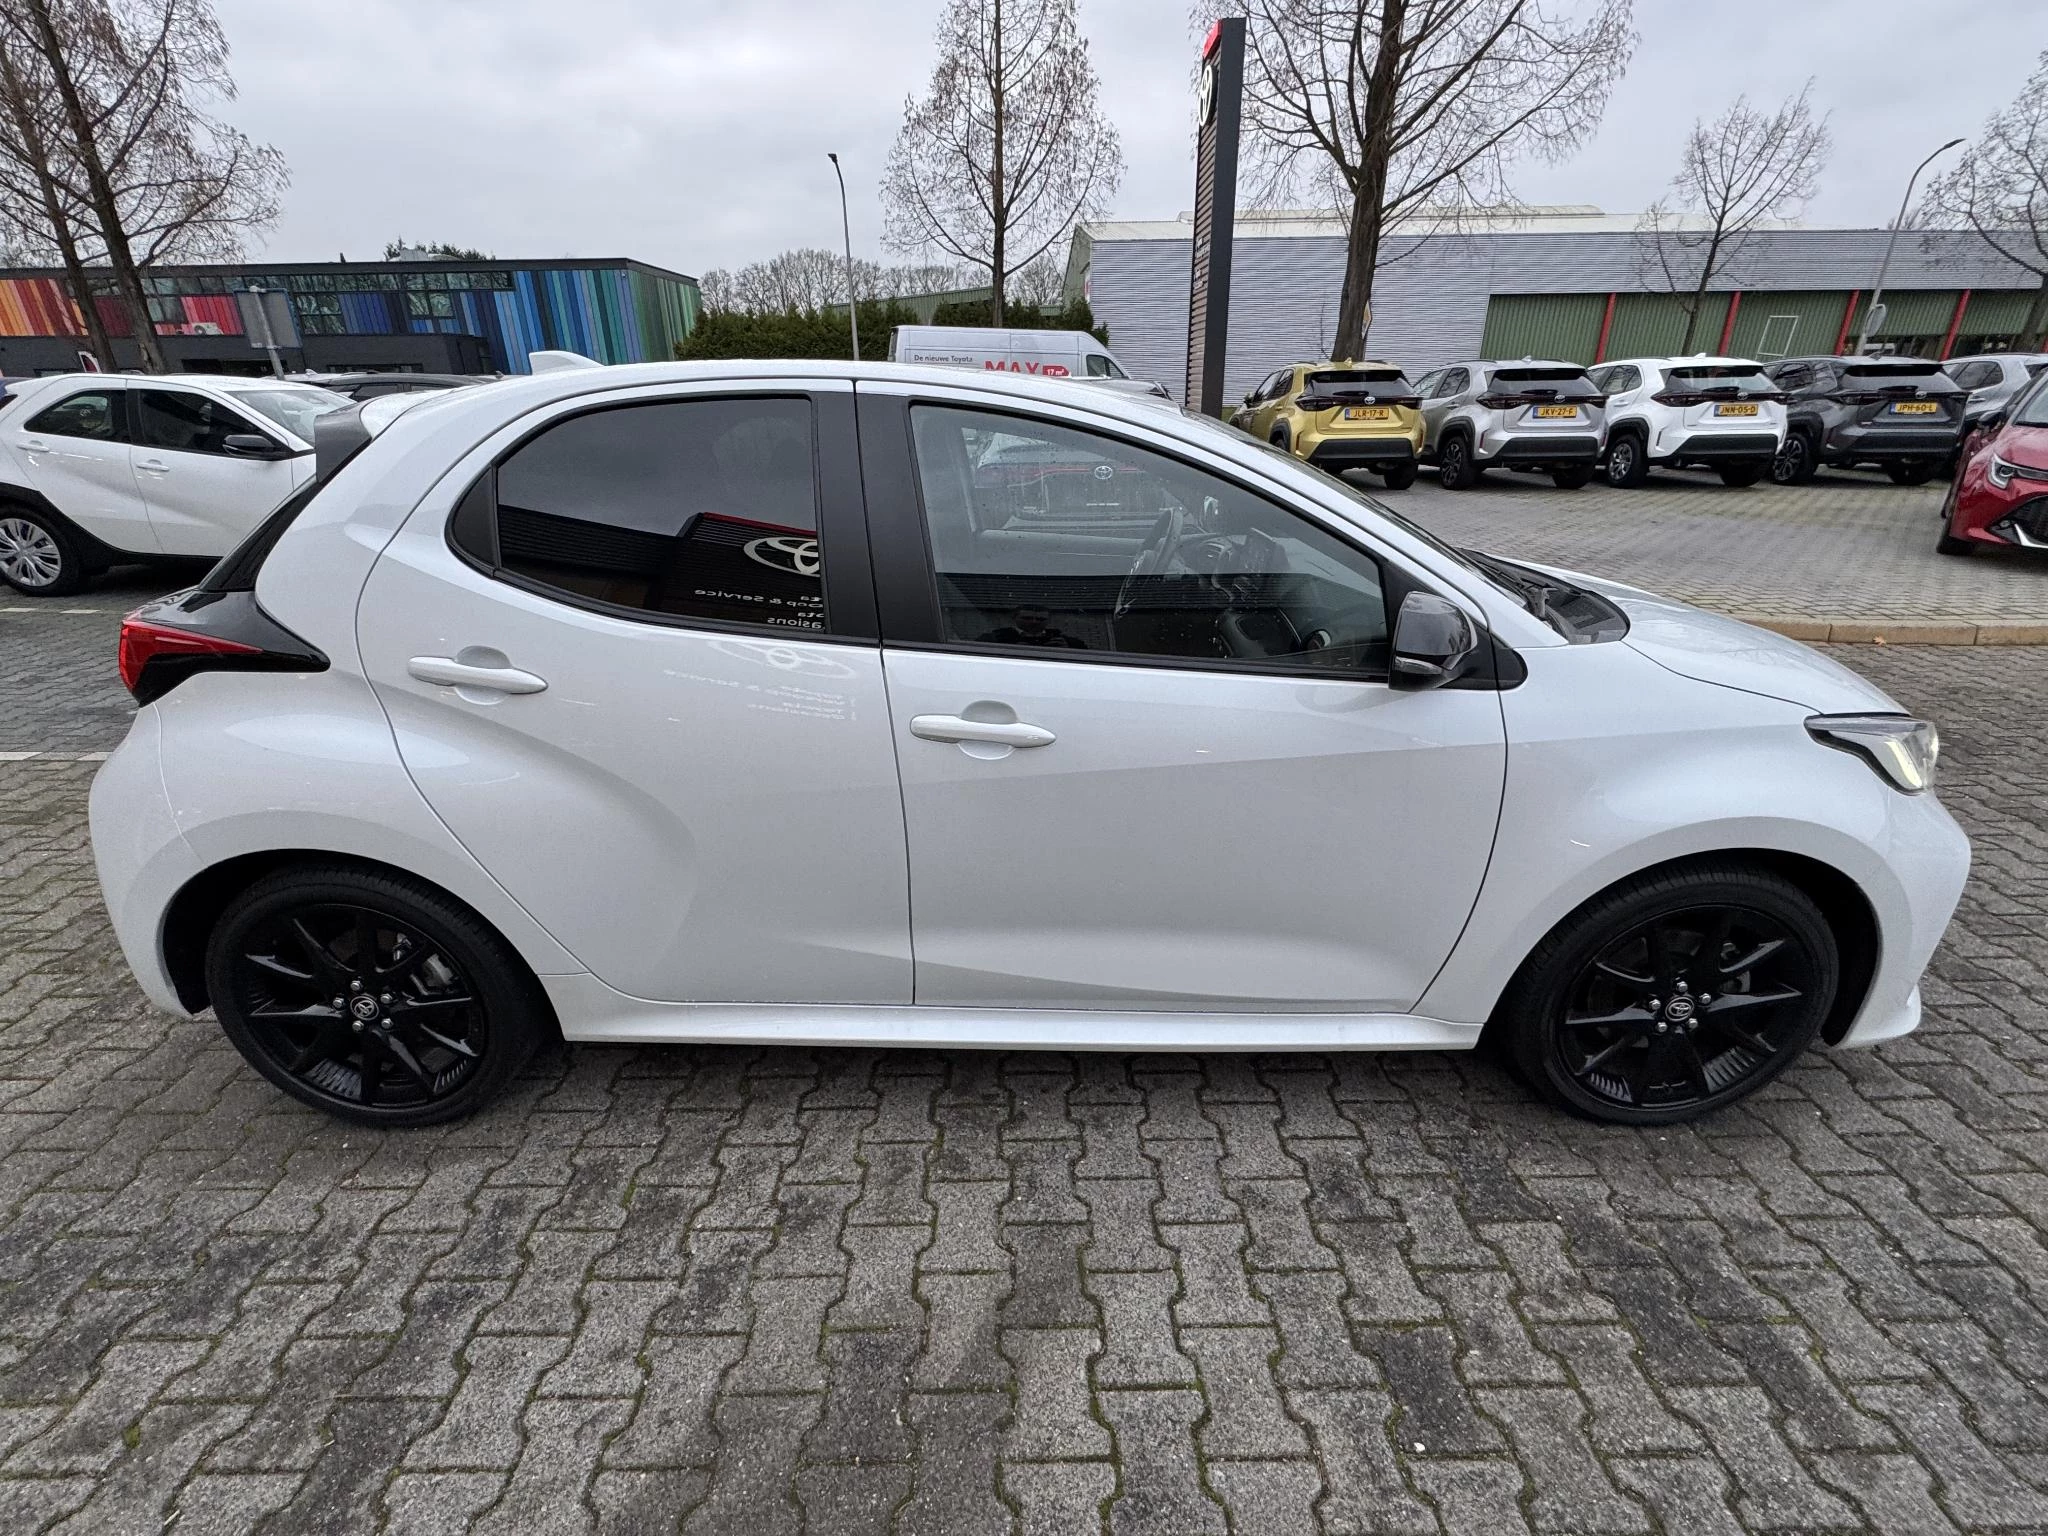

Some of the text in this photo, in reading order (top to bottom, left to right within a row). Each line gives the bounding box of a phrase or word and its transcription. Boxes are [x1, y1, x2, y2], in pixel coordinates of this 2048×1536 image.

[914, 354, 973, 364] De nieuwe Toyota
[1047, 368, 1055, 376] 17
[1353, 409, 1385, 418] JLR-17-R
[1540, 407, 1574, 416] JKV-27-F
